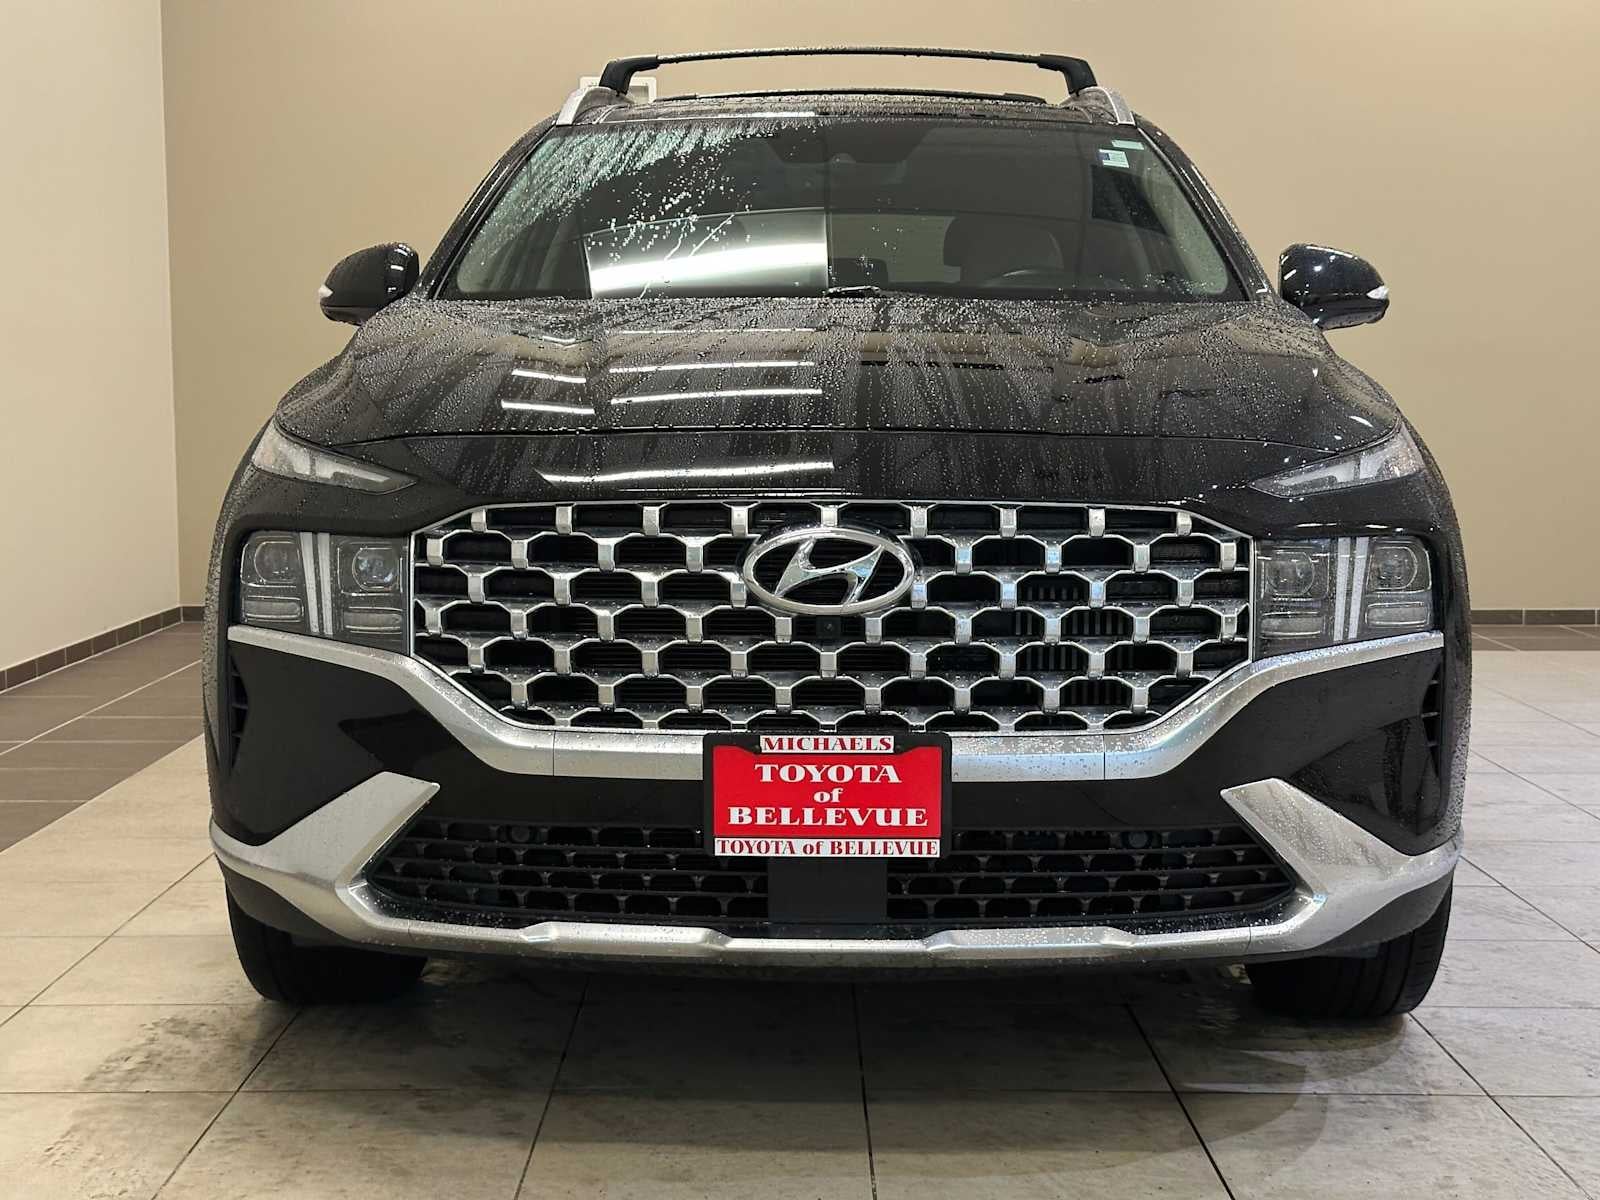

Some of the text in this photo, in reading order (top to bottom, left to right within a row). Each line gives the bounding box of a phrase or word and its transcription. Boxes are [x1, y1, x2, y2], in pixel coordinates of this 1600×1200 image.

[763, 737, 892, 751] MICHAELS
[755, 764, 902, 783] TOYOTA
[813, 788, 843, 803] of
[728, 807, 928, 827] BELLEVUE
[717, 840, 938, 856] TOYOTA of BELLEVUE
